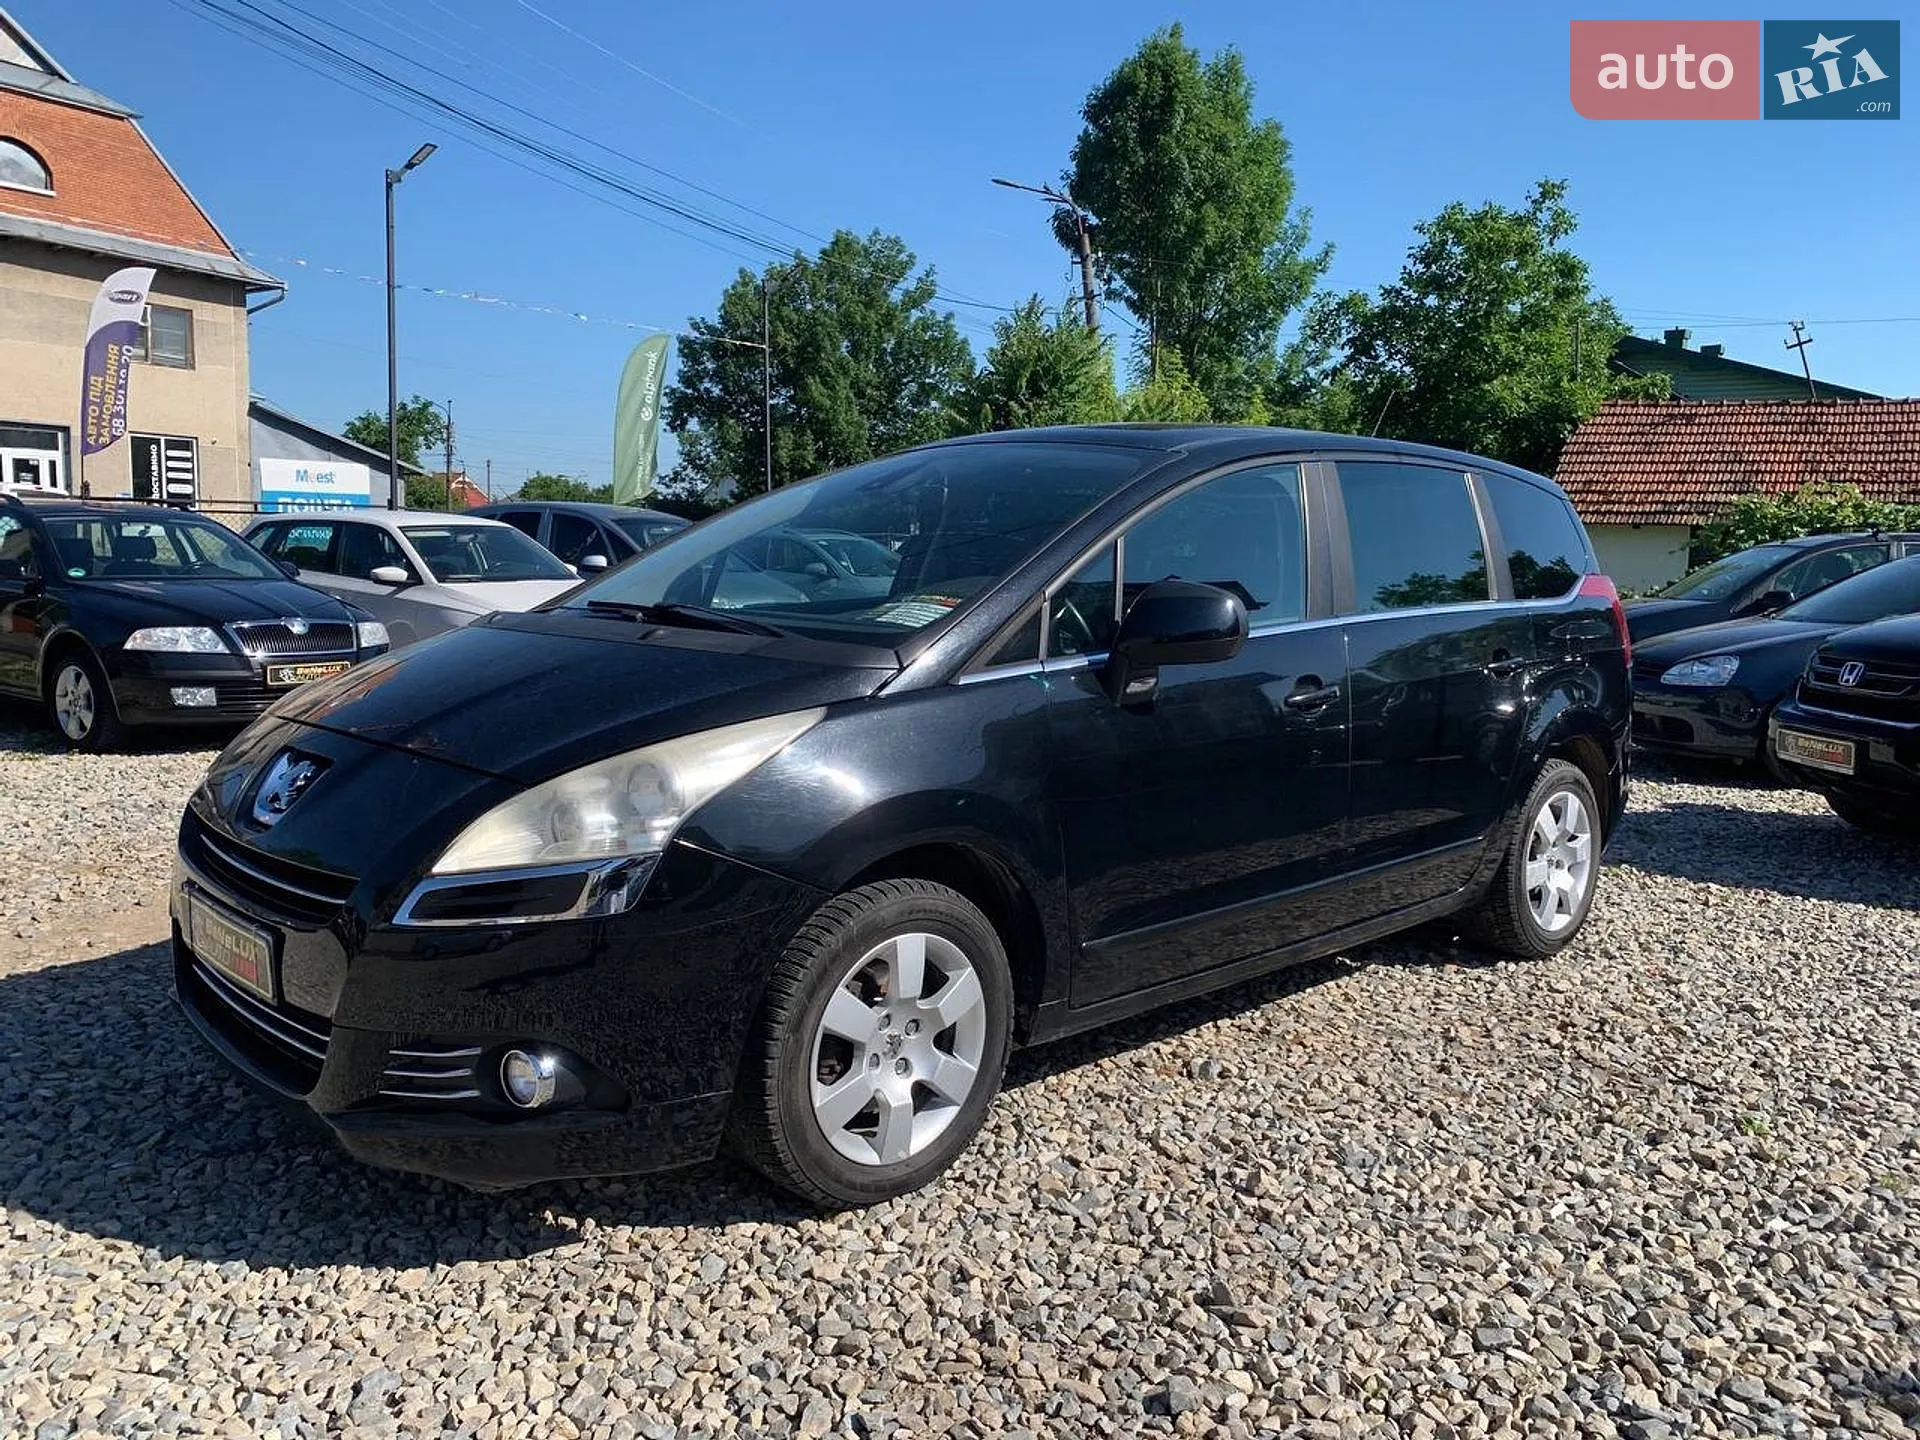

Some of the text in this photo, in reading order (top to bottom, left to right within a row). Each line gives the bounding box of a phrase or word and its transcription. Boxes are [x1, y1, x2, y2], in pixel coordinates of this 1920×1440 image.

[87, 376, 105, 445] АВТО ПІД
[99, 343, 120, 445] ЗАМОВЛЕННЯ
